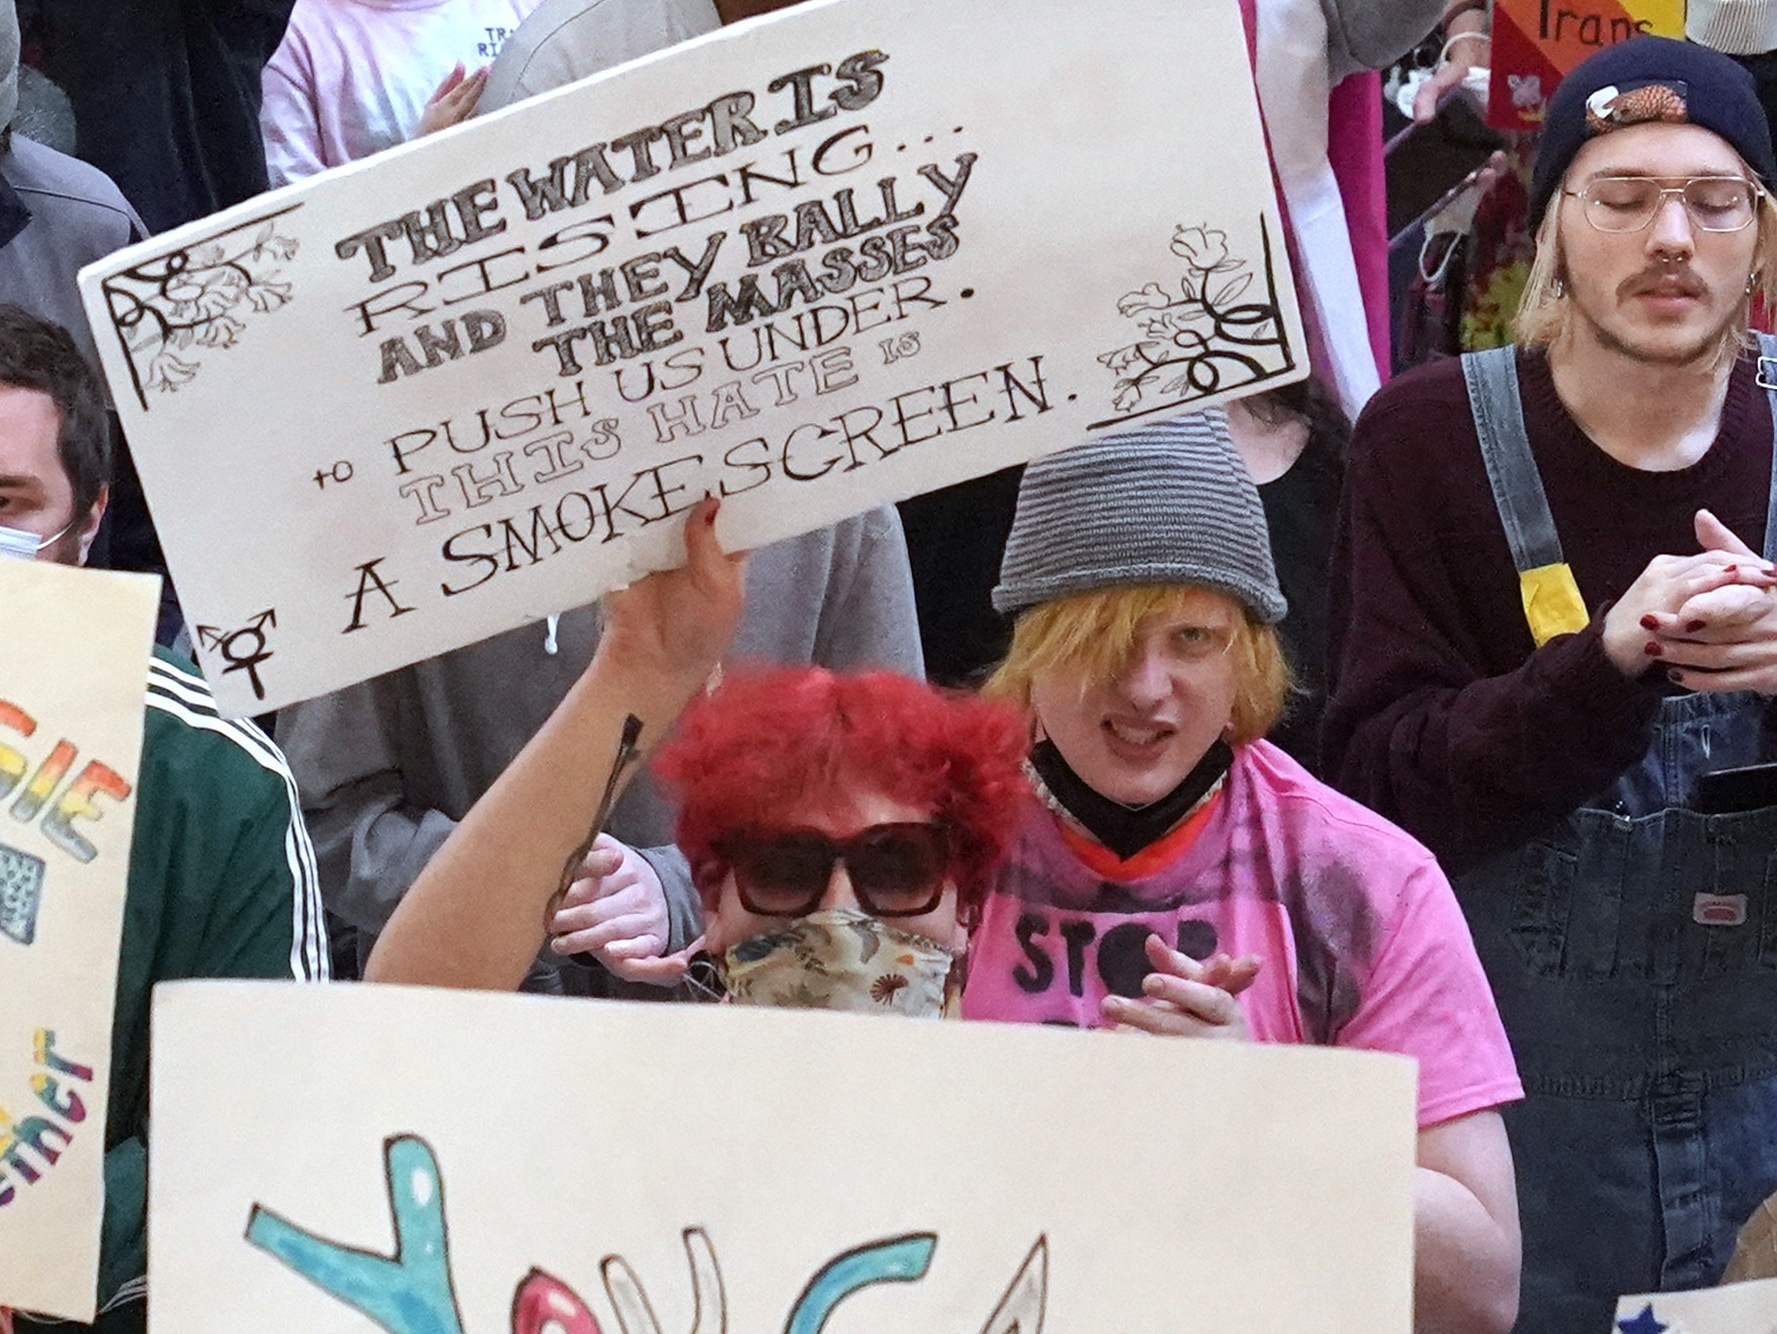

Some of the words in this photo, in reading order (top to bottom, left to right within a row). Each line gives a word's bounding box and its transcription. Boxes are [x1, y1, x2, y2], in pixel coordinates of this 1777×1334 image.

[335, 178, 509, 283] THE
[503, 90, 769, 221] WATER
[768, 48, 890, 138] IS
[377, 308, 507, 385] AND
[519, 229, 727, 328] THEY
[739, 152, 978, 269] RALLY
[532, 300, 685, 377] THE
[704, 212, 960, 334] MASSES
[383, 380, 592, 478] PUSH
[615, 346, 705, 404] US
[398, 416, 624, 526] THIS
[645, 345, 861, 445] HATE
[878, 329, 923, 366] IS
[341, 556, 418, 635] A
